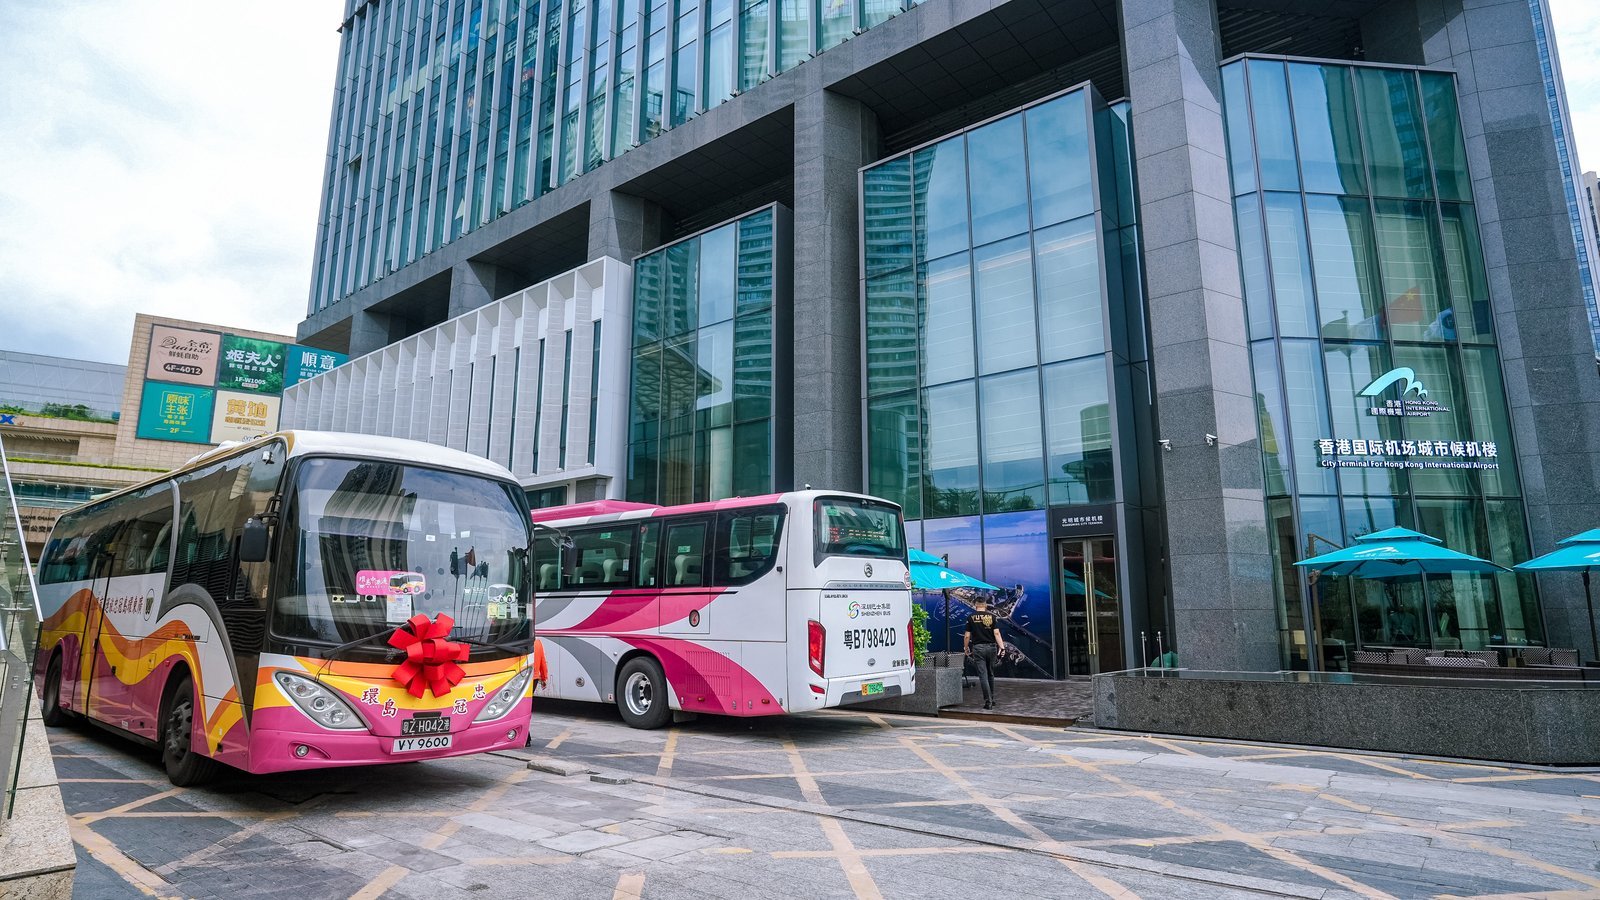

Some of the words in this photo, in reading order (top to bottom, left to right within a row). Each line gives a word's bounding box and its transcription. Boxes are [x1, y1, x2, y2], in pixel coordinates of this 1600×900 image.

[226, 349, 278, 368] 姬夫人
[165, 364, 201, 375] 4F-4012
[1319, 439, 1498, 458] 香港国际机场城市候机楼
[1321, 460, 1337, 468] City
[1384, 461, 1403, 469] Hong
[1405, 461, 1423, 469] Kong
[1425, 461, 1472, 469] International
[1473, 462, 1499, 470] Airport
[843, 627, 897, 650] 粤B79842D
[398, 740, 413, 750] VY
[417, 737, 449, 749] 9600
